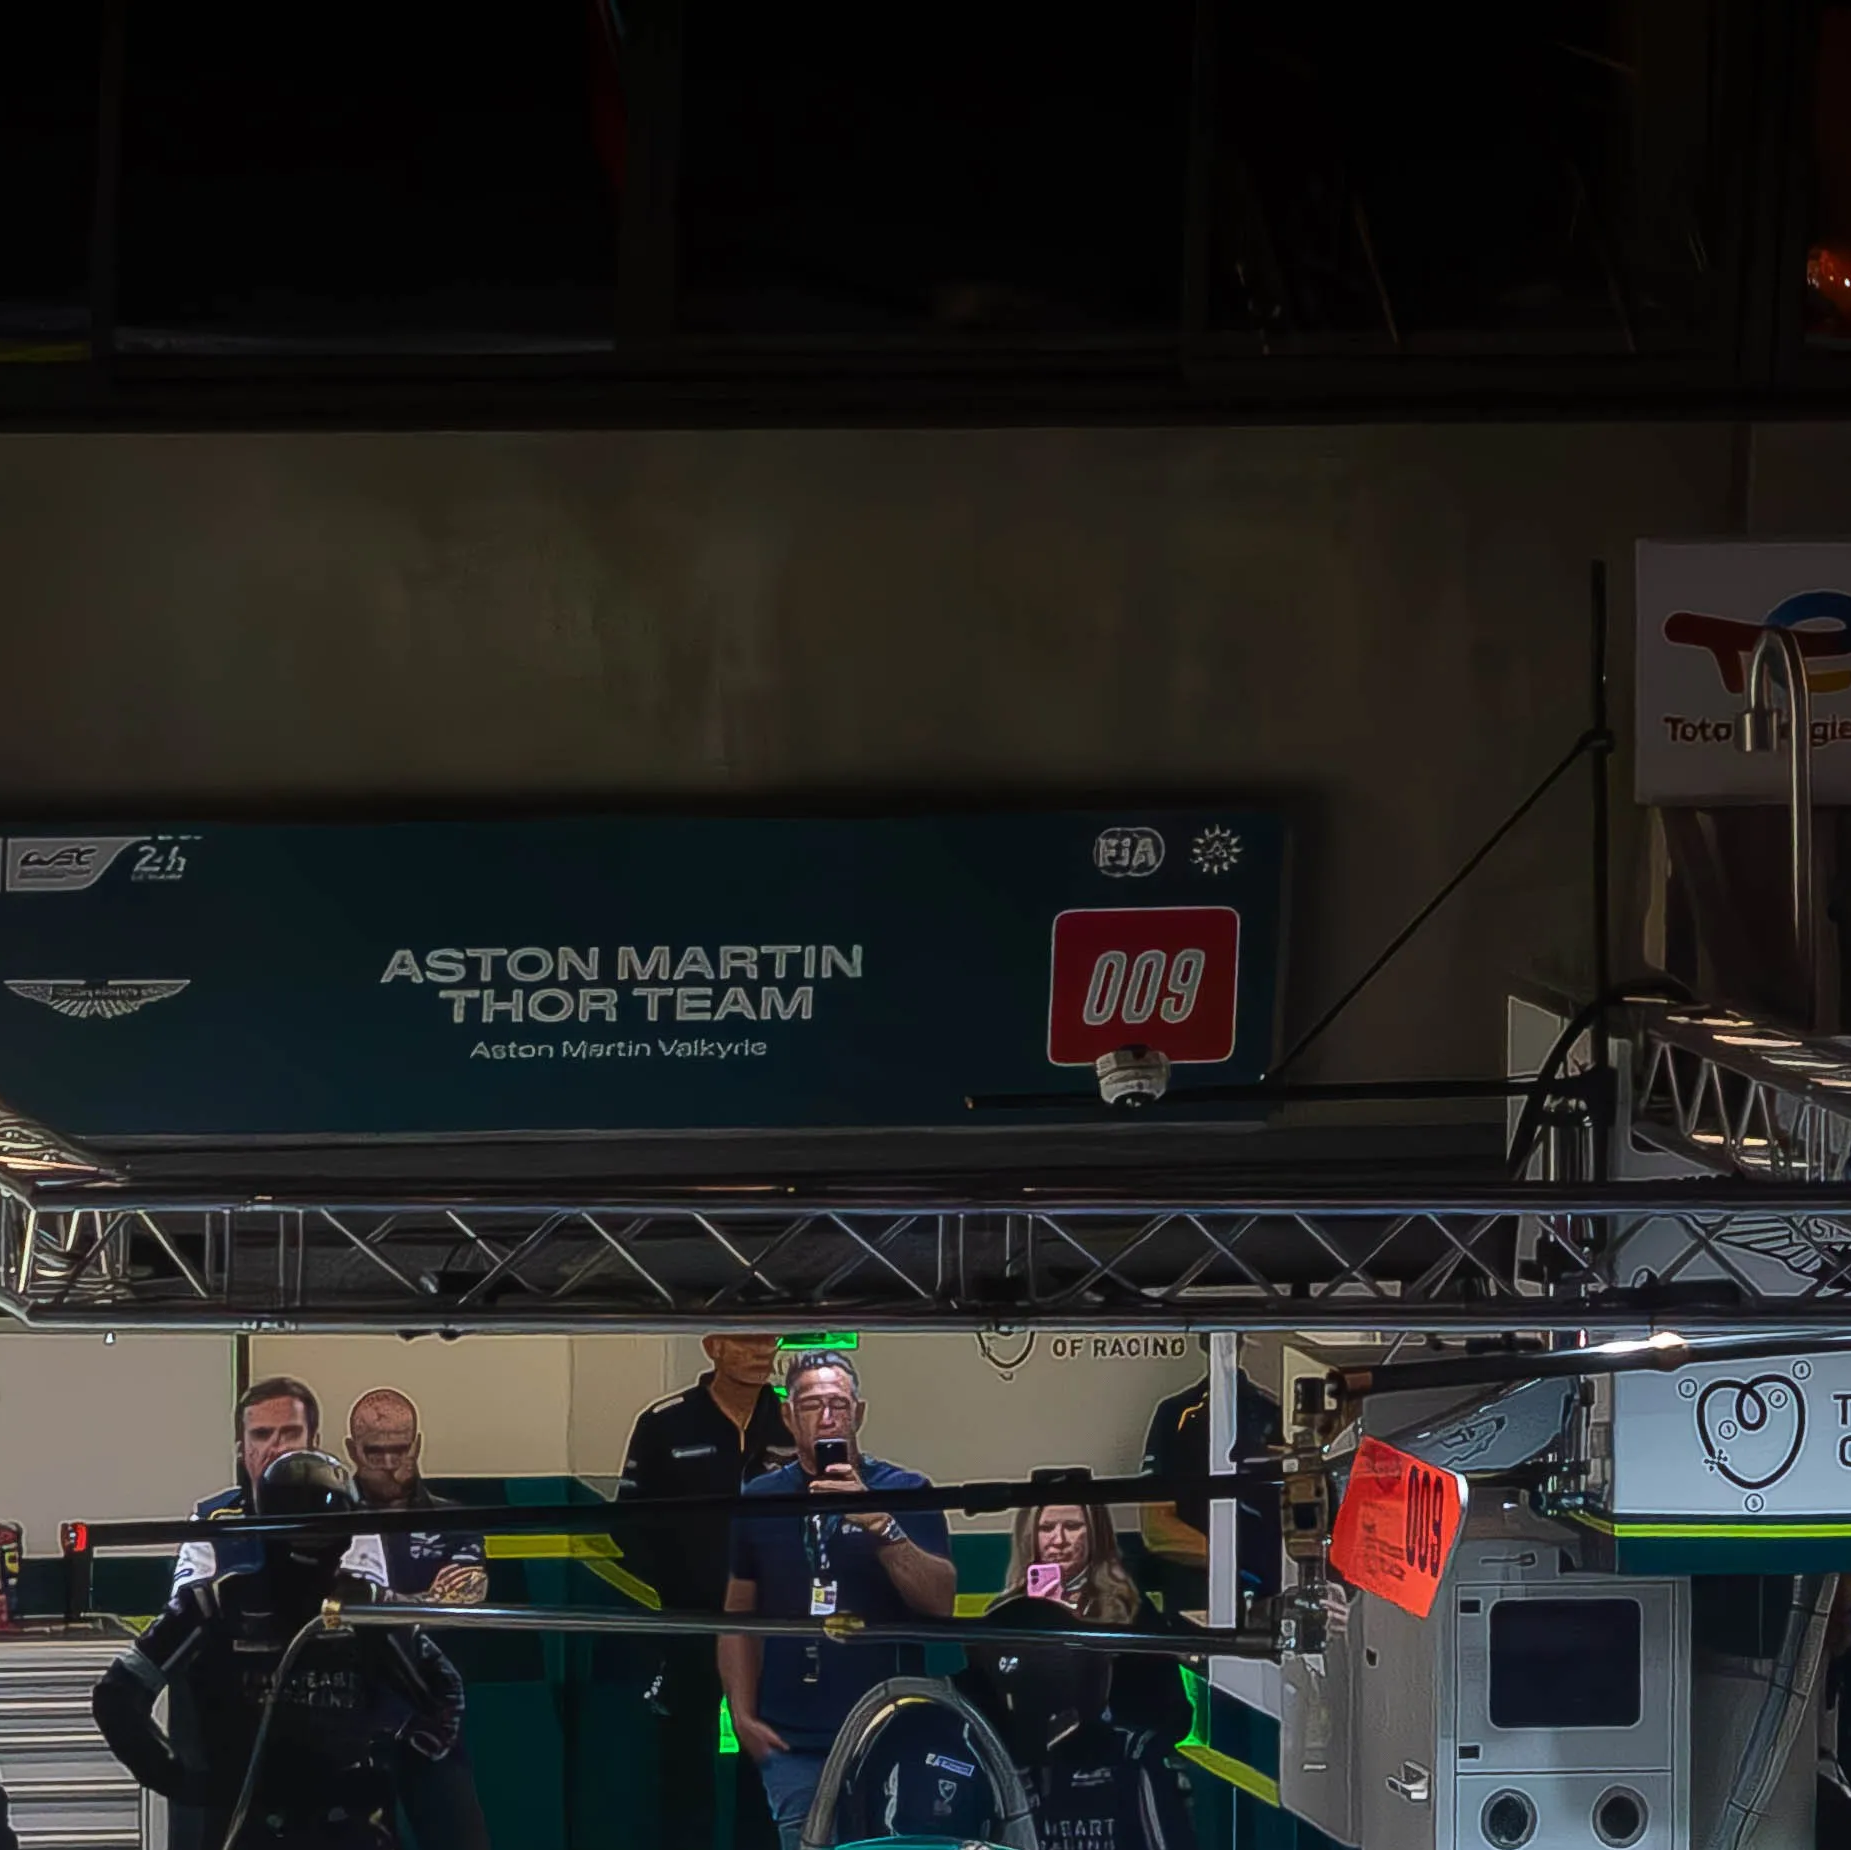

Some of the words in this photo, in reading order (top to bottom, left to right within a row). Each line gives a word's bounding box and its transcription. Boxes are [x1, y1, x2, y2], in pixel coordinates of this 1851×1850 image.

[1096, 836, 1158, 869] FIA
[380, 946, 600, 984] ASTON
[616, 944, 863, 981] MARTIN
[438, 987, 619, 1025] THOR
[632, 985, 815, 1022] TEAM
[1082, 948, 1206, 1026] 009
[470, 1040, 554, 1060] Aston
[561, 1037, 652, 1059] Martin
[657, 1036, 768, 1063] Valkyrie
[1052, 1338, 1083, 1358] OF
